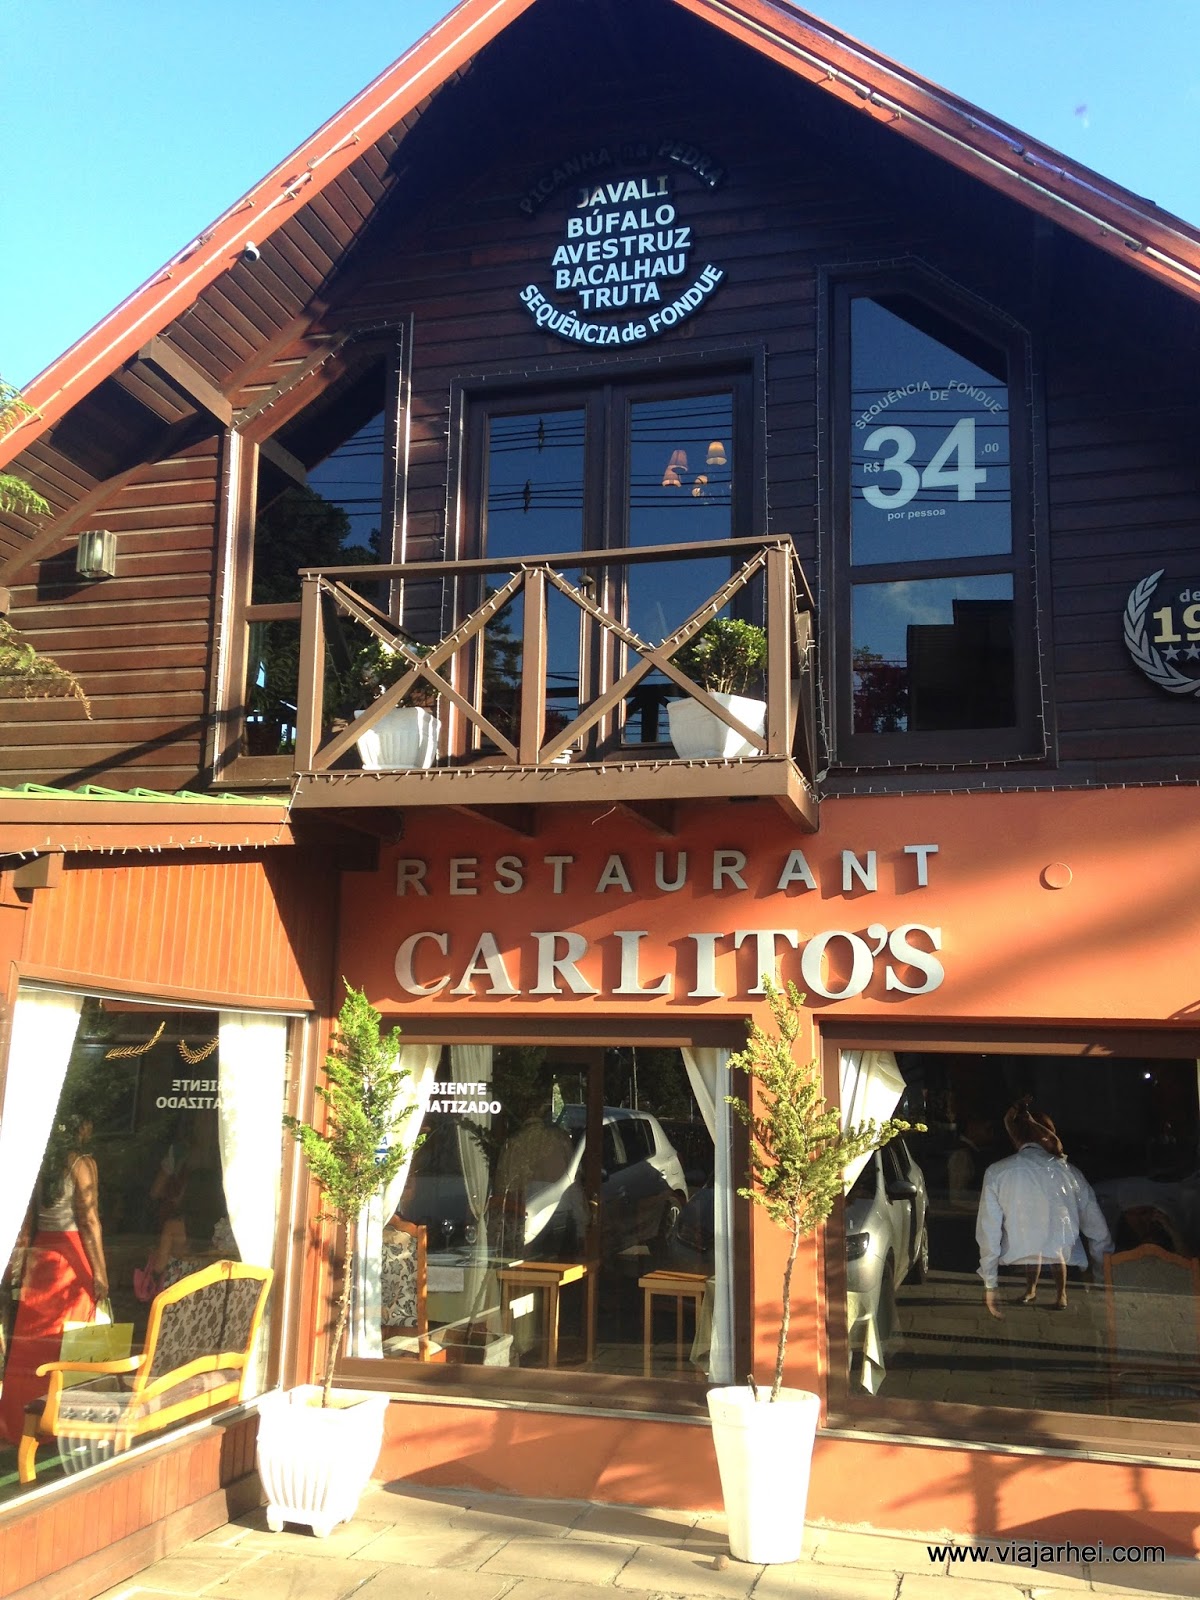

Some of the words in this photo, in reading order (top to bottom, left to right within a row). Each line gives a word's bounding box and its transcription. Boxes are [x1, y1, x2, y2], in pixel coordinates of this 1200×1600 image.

[576, 175, 669, 209] JAVALI
[567, 204, 676, 238] BÚFALO
[551, 227, 691, 266] AVESTRUZ
[555, 253, 686, 289] BACALHAU
[519, 284, 620, 345] SEQUÊNCIA
[621, 322, 647, 342] de
[648, 264, 724, 332] FONDUE
[578, 281, 660, 310] TRUTA
[855, 380, 931, 430] SEQUÊNCIA
[930, 390, 949, 401] DE
[947, 379, 1003, 415] FONDUE
[861, 417, 987, 510] 34
[863, 462, 880, 473] R$
[887, 511, 904, 521] por
[908, 508, 946, 520] pessoa
[1152, 603, 1200, 643] 19
[396, 844, 939, 896] RESTAURANT
[394, 923, 945, 1000] CARLITO'S
